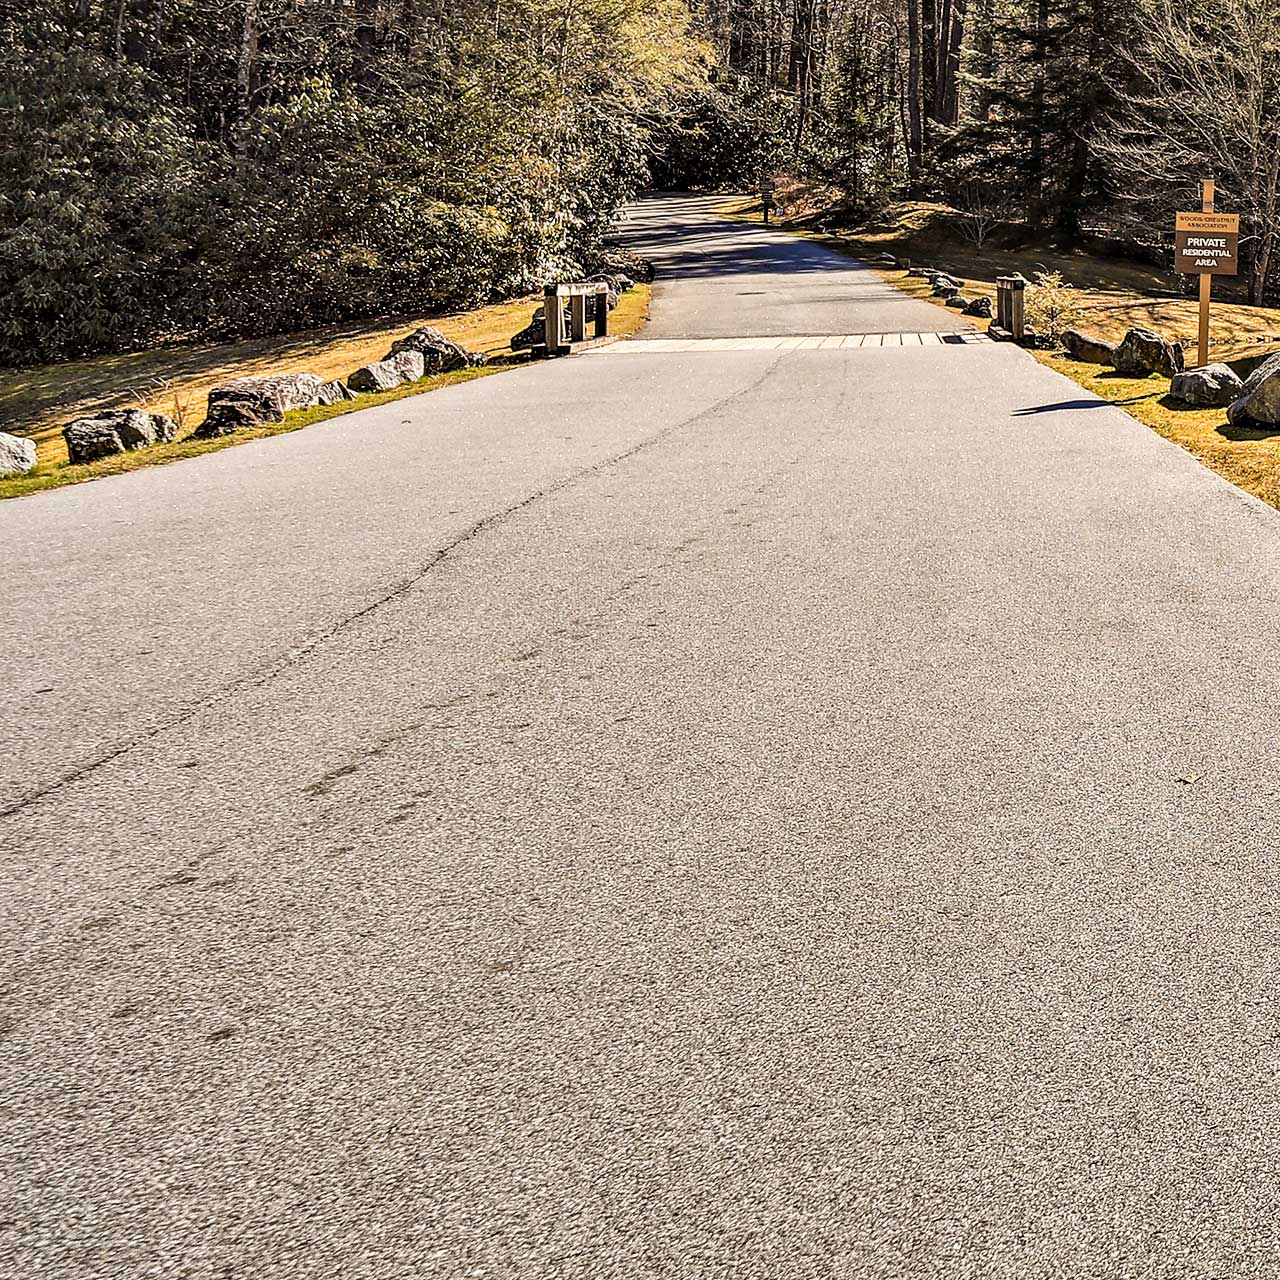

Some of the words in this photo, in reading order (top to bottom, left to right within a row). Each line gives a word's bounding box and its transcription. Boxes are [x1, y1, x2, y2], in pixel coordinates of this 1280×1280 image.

[1187, 222, 1228, 230] ASSOCIATION
[1187, 237, 1227, 248] PRIVATE
[1182, 248, 1232, 258] RESIDENTIAL
[1194, 258, 1218, 267] AREA
